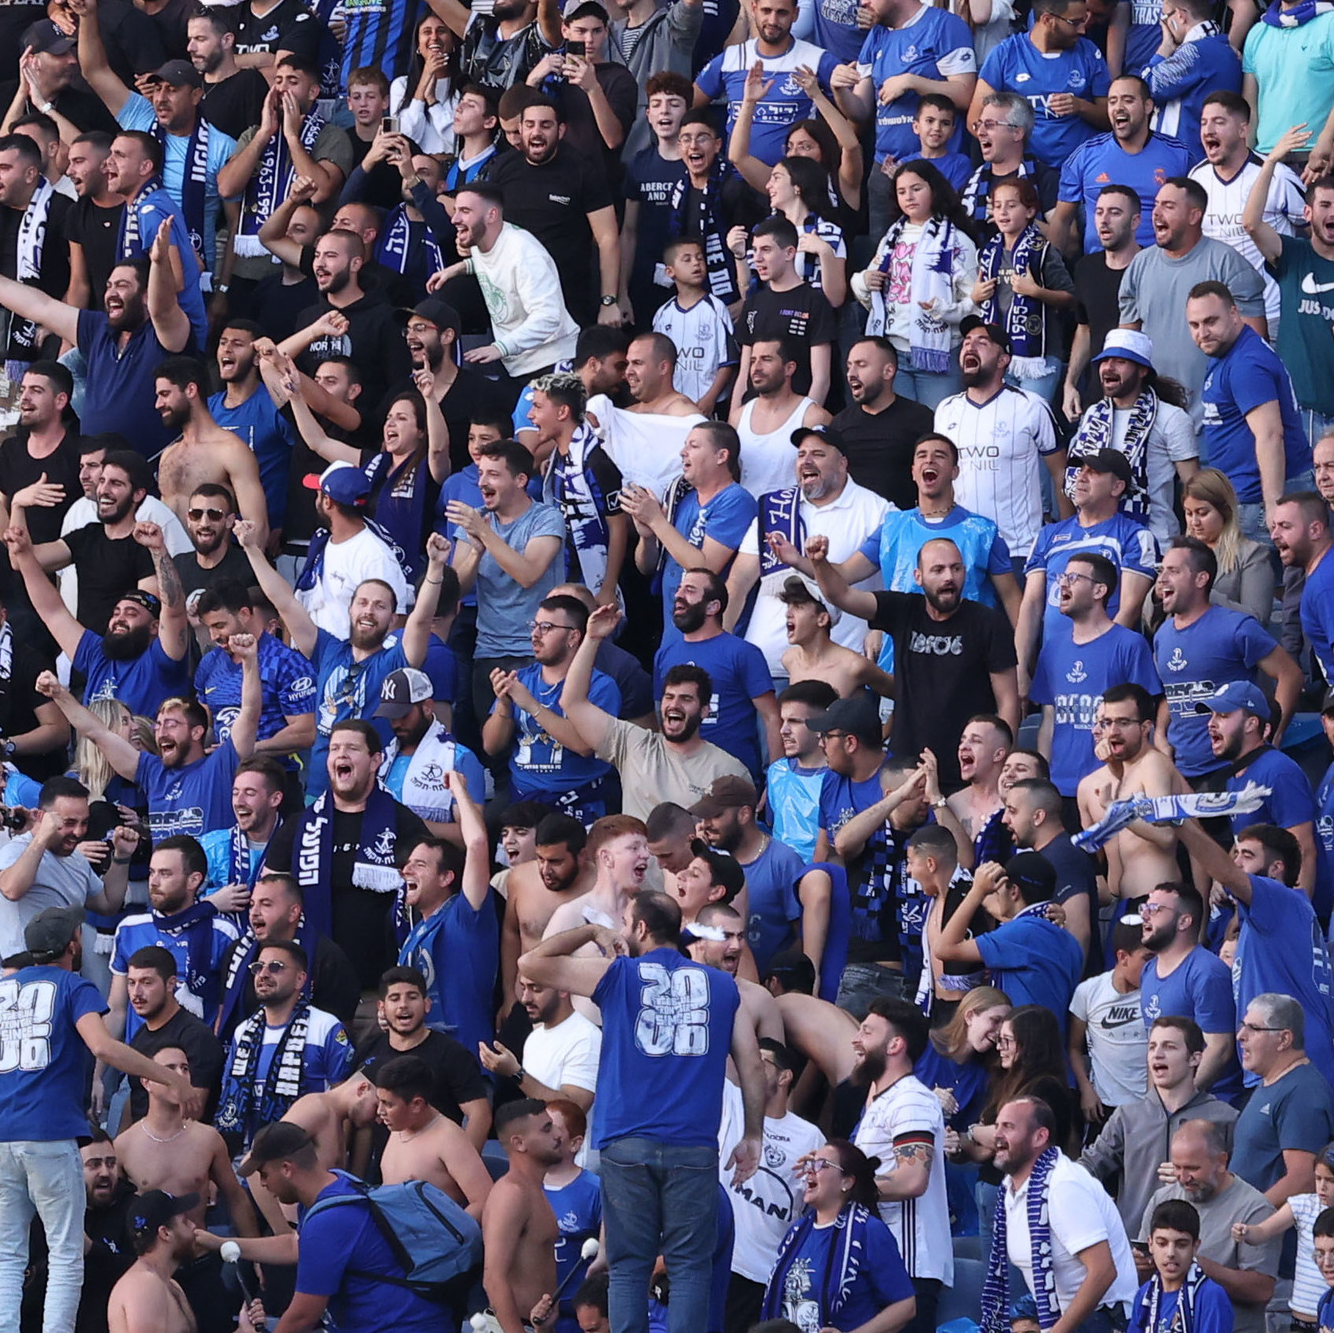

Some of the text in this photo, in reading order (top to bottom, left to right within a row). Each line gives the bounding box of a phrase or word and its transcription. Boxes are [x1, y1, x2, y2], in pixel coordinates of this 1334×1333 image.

[647, 192, 666, 201] AND
[1298, 299, 1321, 315] JUS
[676, 347, 705, 358] WO
[957, 446, 1000, 458] TWO
[969, 459, 1000, 471] NIL
[288, 687, 317, 701] HYUNDAI
[298, 816, 325, 886] הפועל
[1108, 1007, 1139, 1020] NIKE
[276, 1017, 308, 1096] HAPOEL
